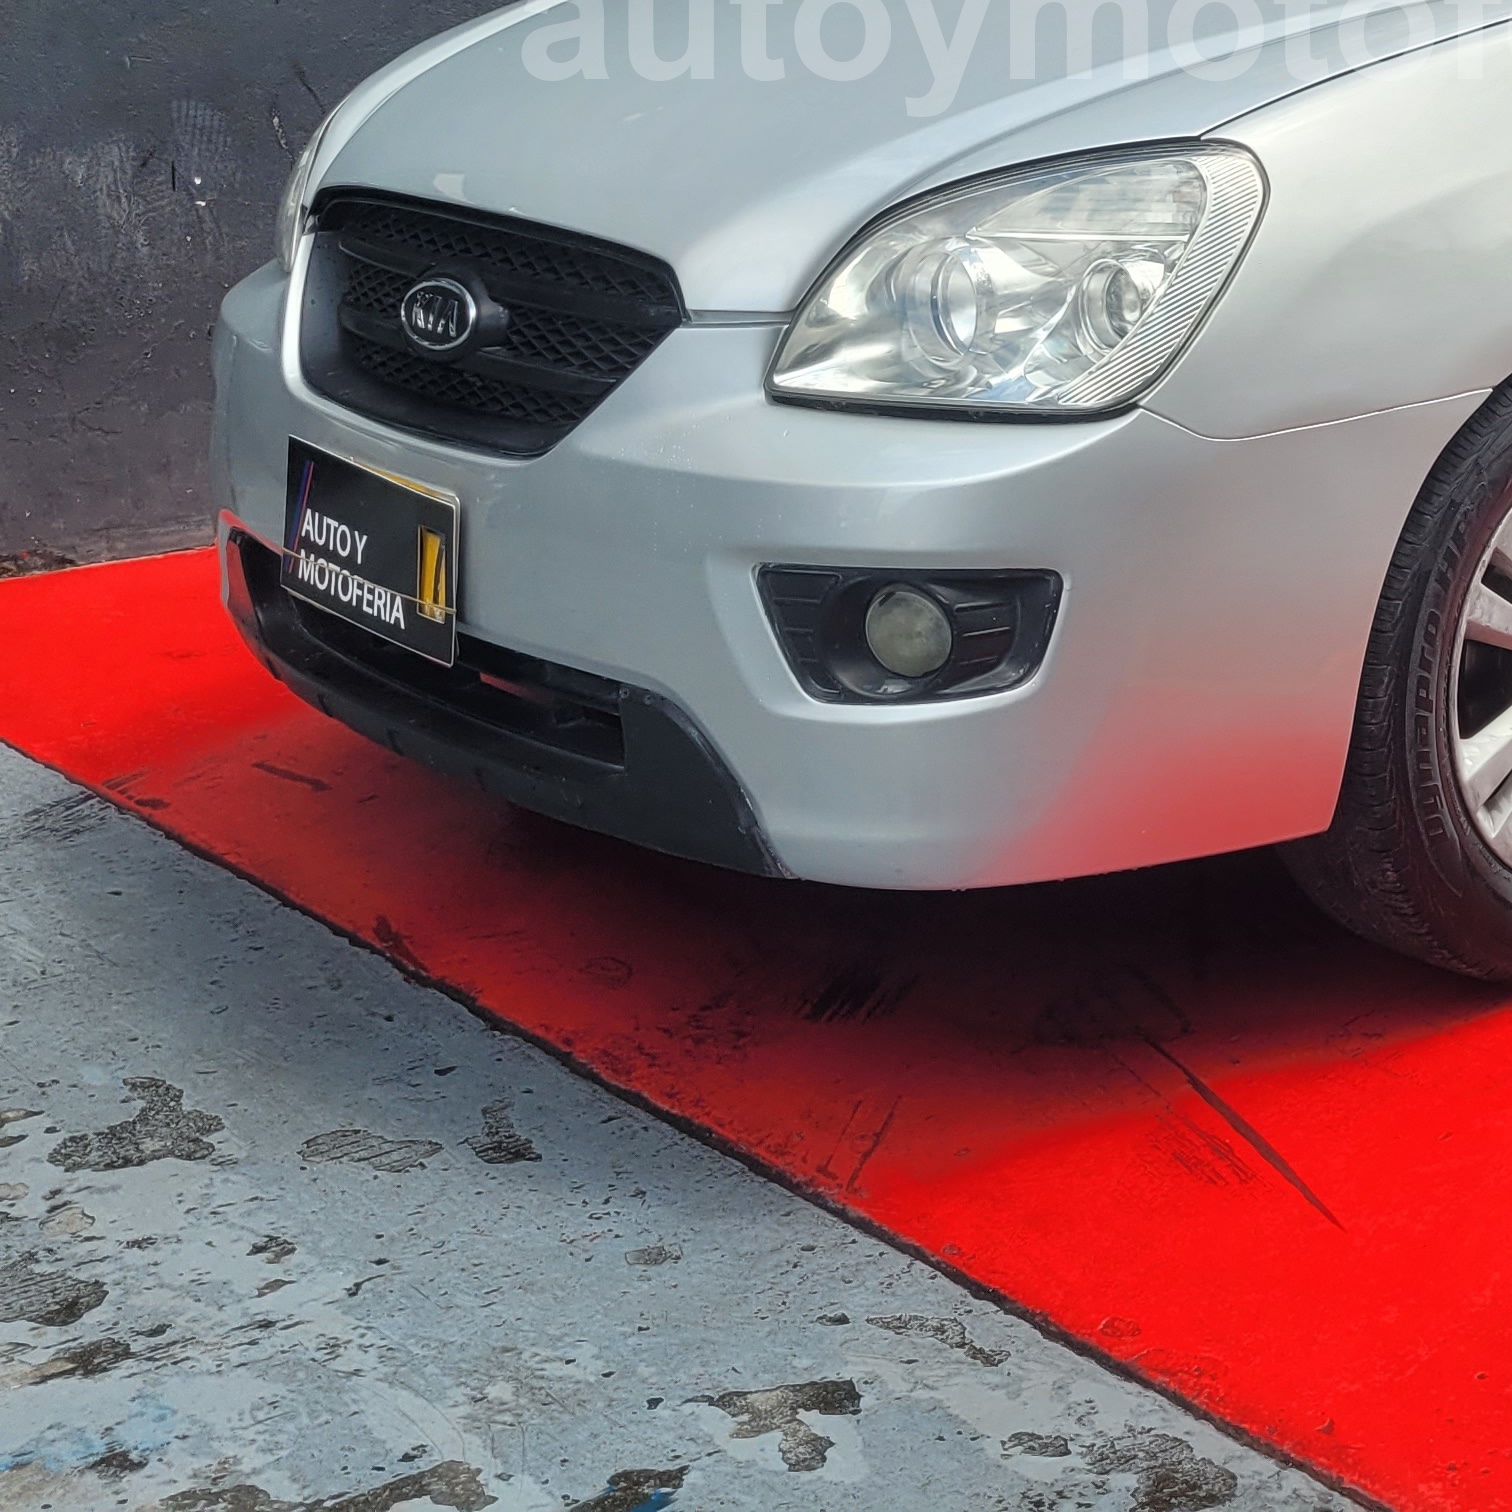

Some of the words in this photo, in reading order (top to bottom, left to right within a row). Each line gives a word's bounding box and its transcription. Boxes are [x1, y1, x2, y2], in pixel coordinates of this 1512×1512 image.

[301, 508, 351, 557] AUTO
[354, 530, 368, 565] Y
[298, 548, 405, 630] MOTOFERIA
